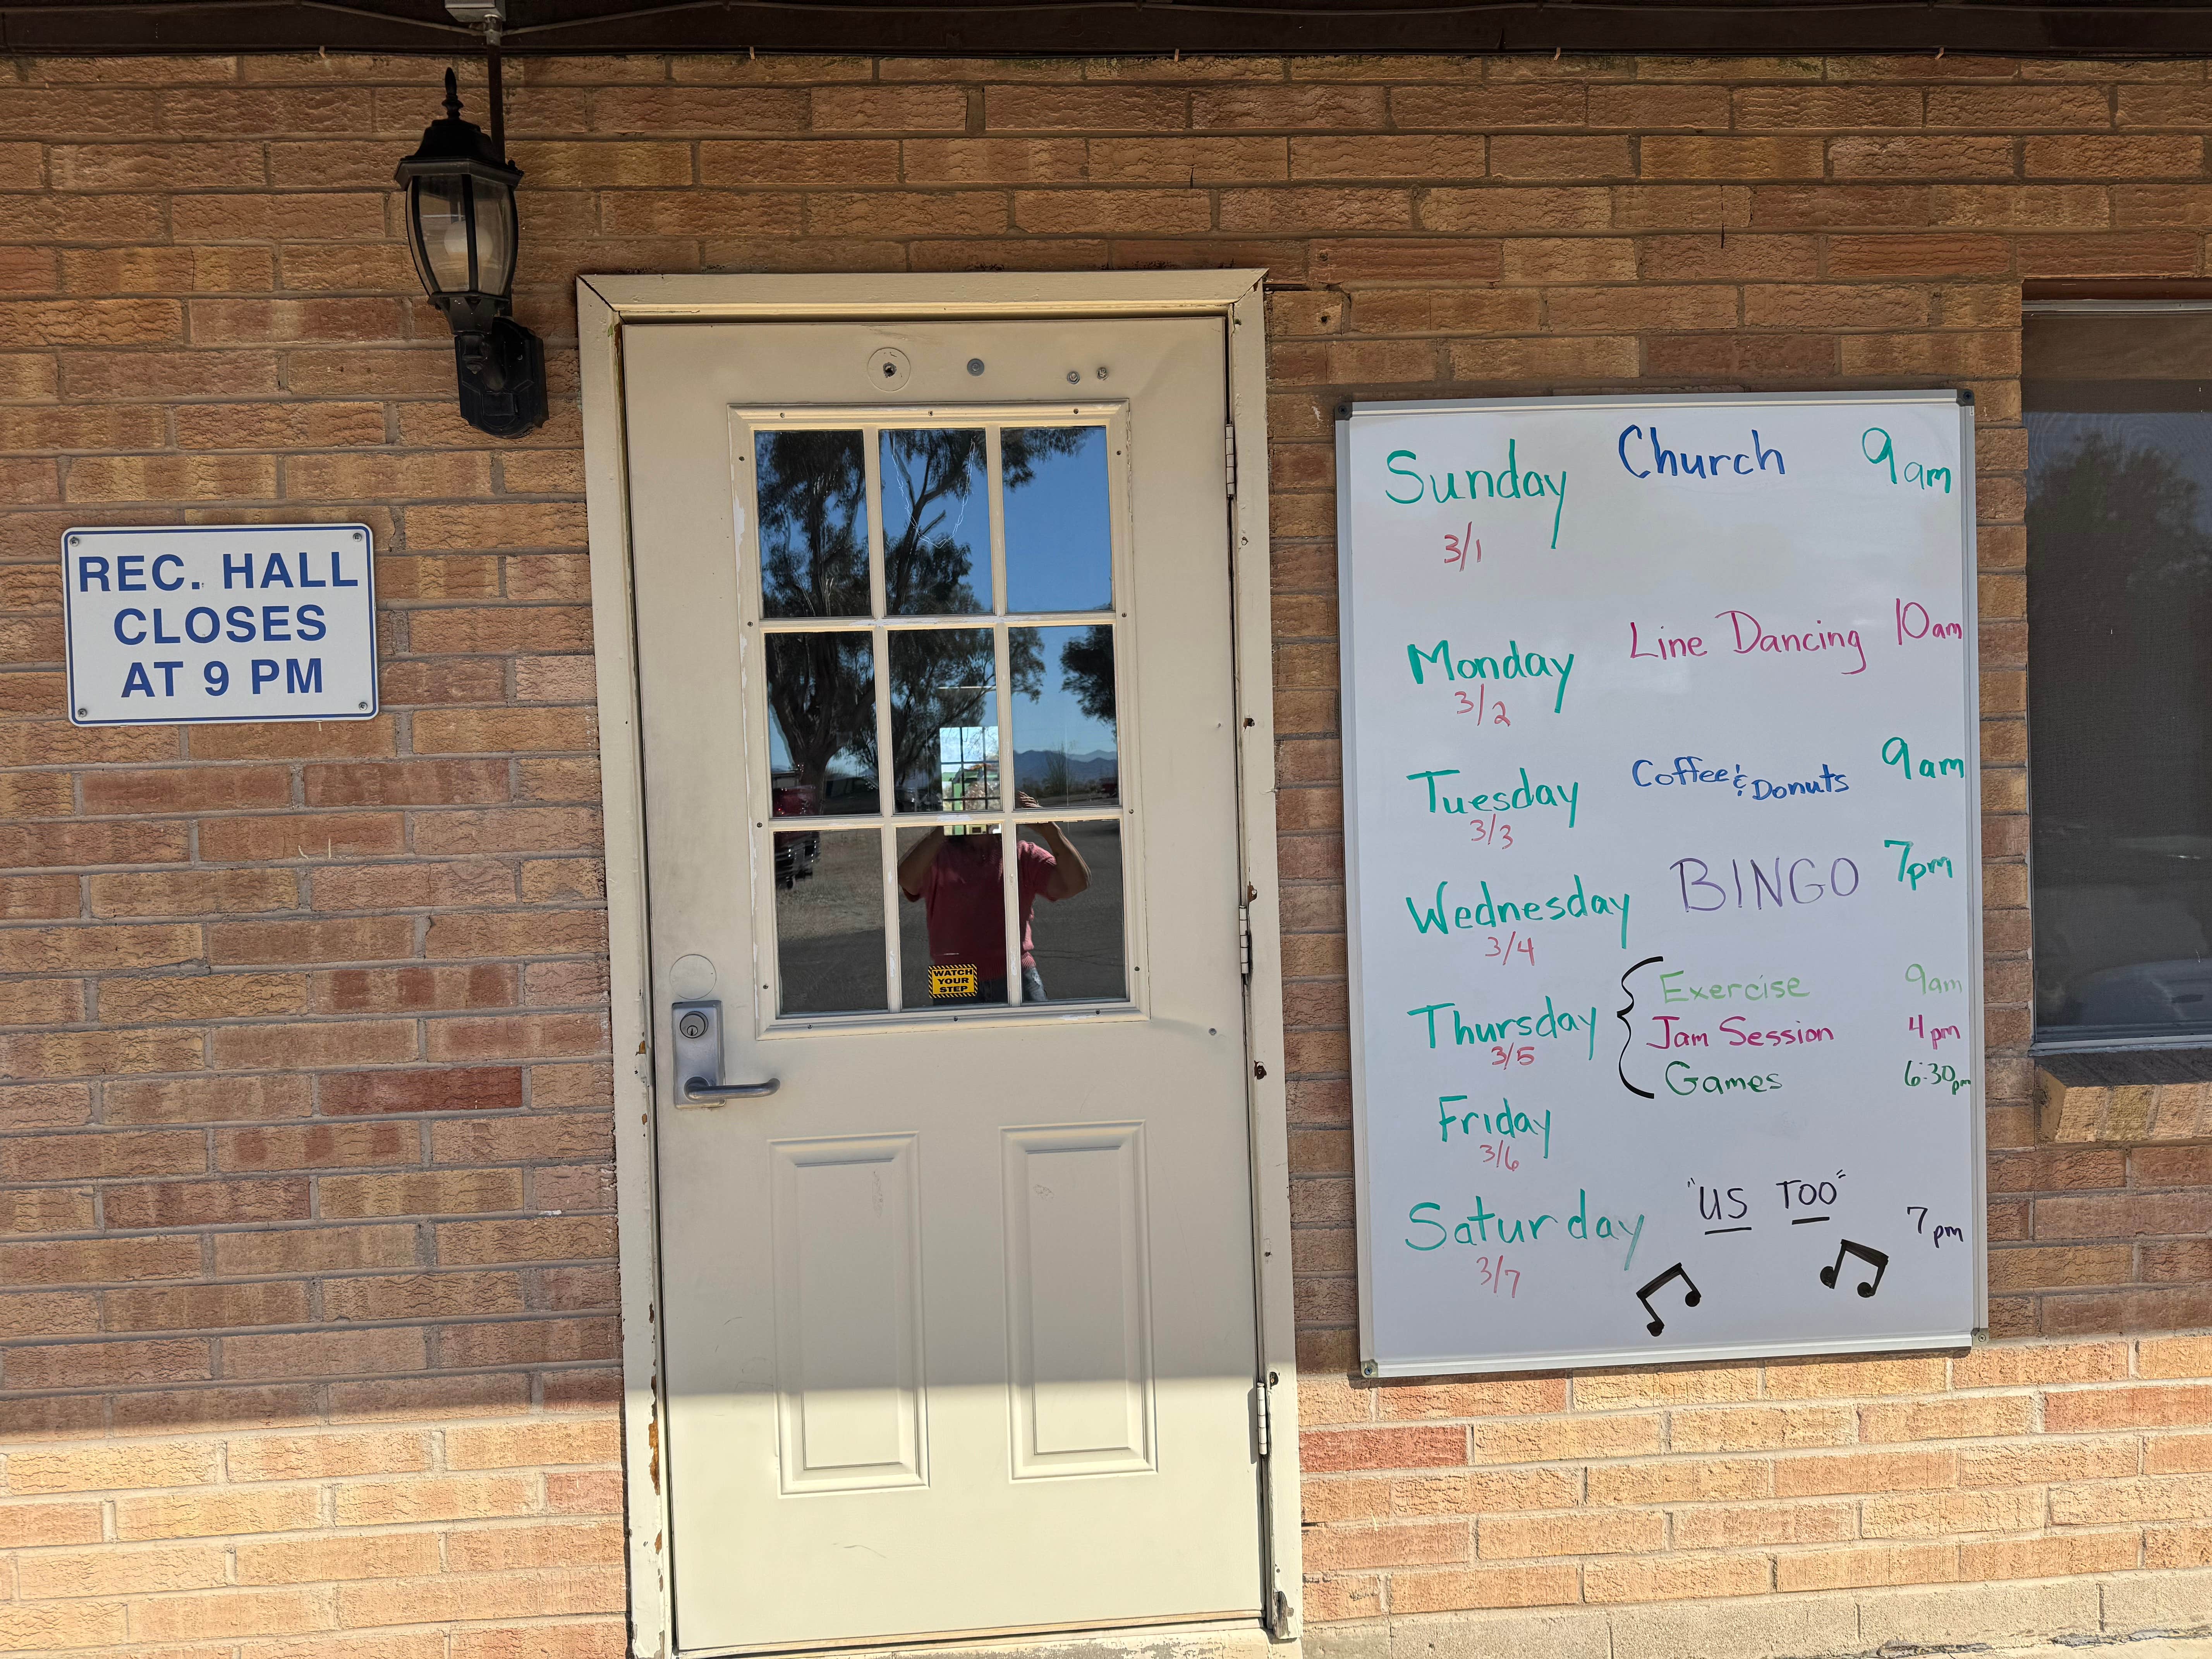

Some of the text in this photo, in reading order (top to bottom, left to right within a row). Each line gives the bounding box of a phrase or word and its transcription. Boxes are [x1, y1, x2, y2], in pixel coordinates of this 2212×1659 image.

[1385, 424, 1951, 550] Sunday Church 9am
[1444, 521, 1482, 572] 3/1
[79, 551, 359, 592] REC. HALL
[114, 604, 327, 646] CLOSES
[1407, 598, 1963, 714] Monday Line Dancing 10am
[120, 658, 323, 698] AT 9 PM
[1454, 683, 1511, 727] 3/2
[1406, 767, 1578, 828] Tuesday
[1632, 756, 1730, 787] Coffee
[1751, 763, 1850, 801] Donuts
[1882, 737, 1965, 780] 9am
[1470, 813, 1513, 850] 3/3
[1405, 840, 1953, 950] Wednesday BINGO 7pm
[1485, 931, 1535, 966] 3/4
[1660, 963, 1962, 1003] Exercise 9am
[1407, 995, 1961, 1061] Thursday Jam Session 4pm
[1491, 1042, 1535, 1067] 3/5
[1665, 1060, 1783, 1096] Games
[1438, 1095, 1551, 1159] Friday
[1479, 1140, 1519, 1172] 3/6
[1405, 1188, 1645, 1271] Saturday
[1476, 1255, 1520, 1298] 3/7
